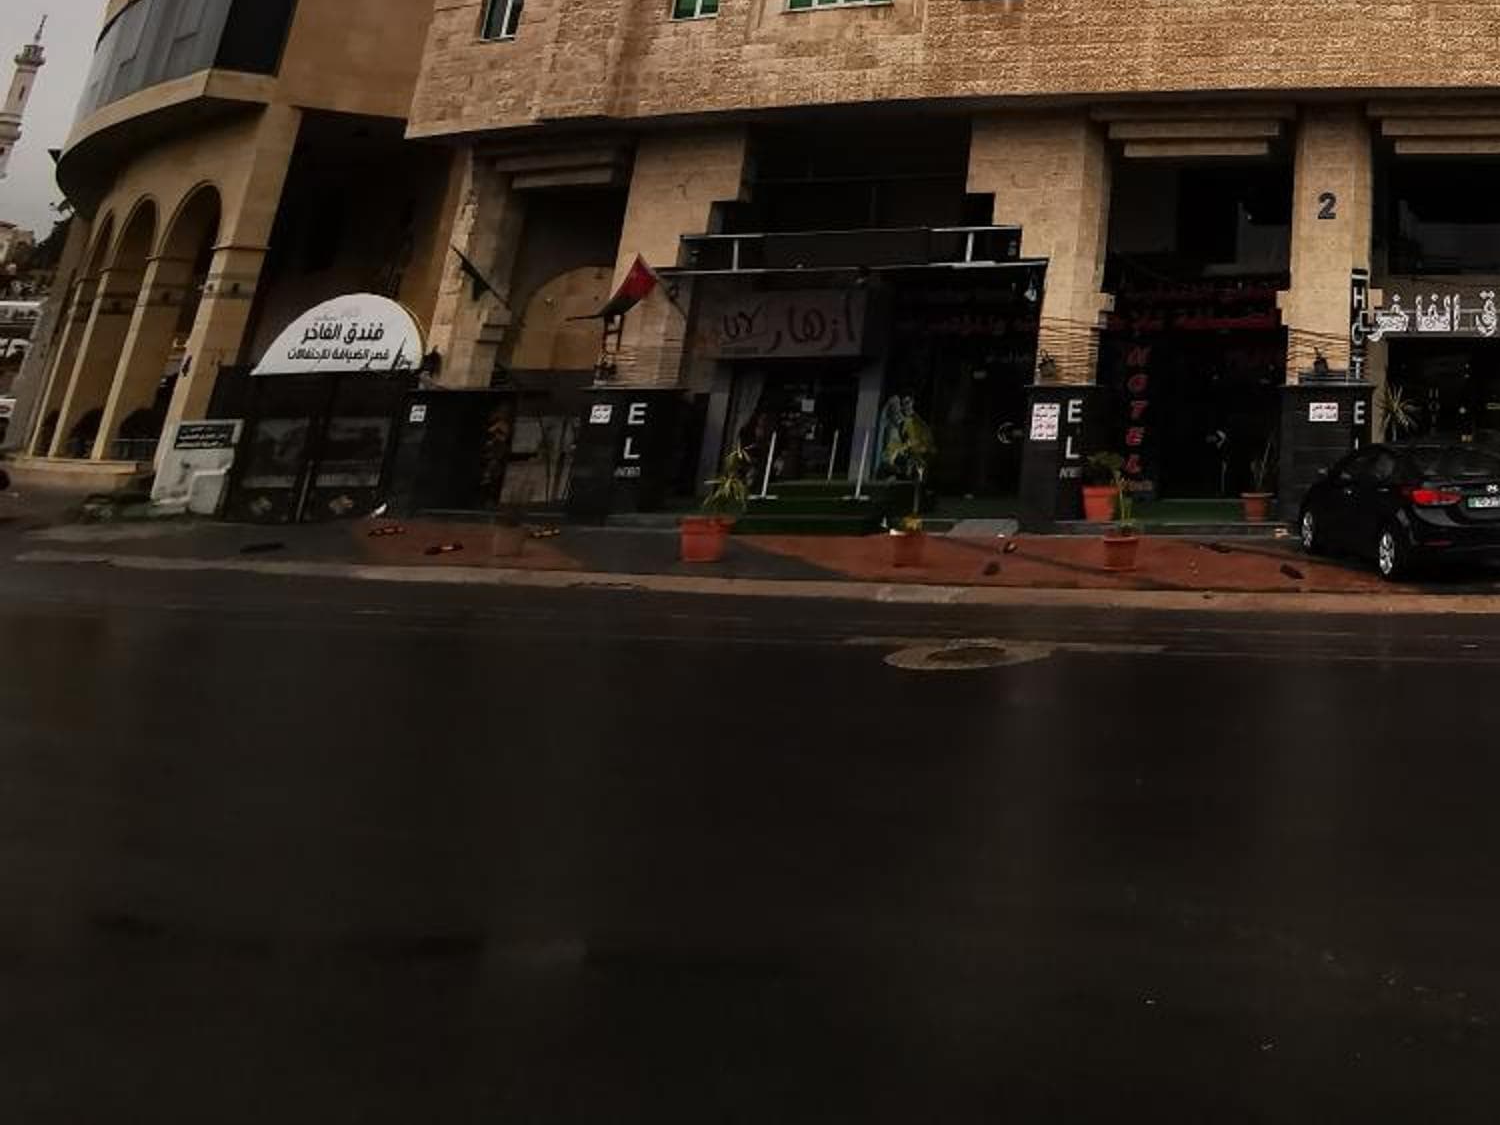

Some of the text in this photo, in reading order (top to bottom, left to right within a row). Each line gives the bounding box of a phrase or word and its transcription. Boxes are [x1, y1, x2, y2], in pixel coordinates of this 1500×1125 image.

[1317, 191, 1337, 220] 2
[1367, 293, 1461, 342] الفاخر
[301, 322, 385, 345] فندق الفاخر
